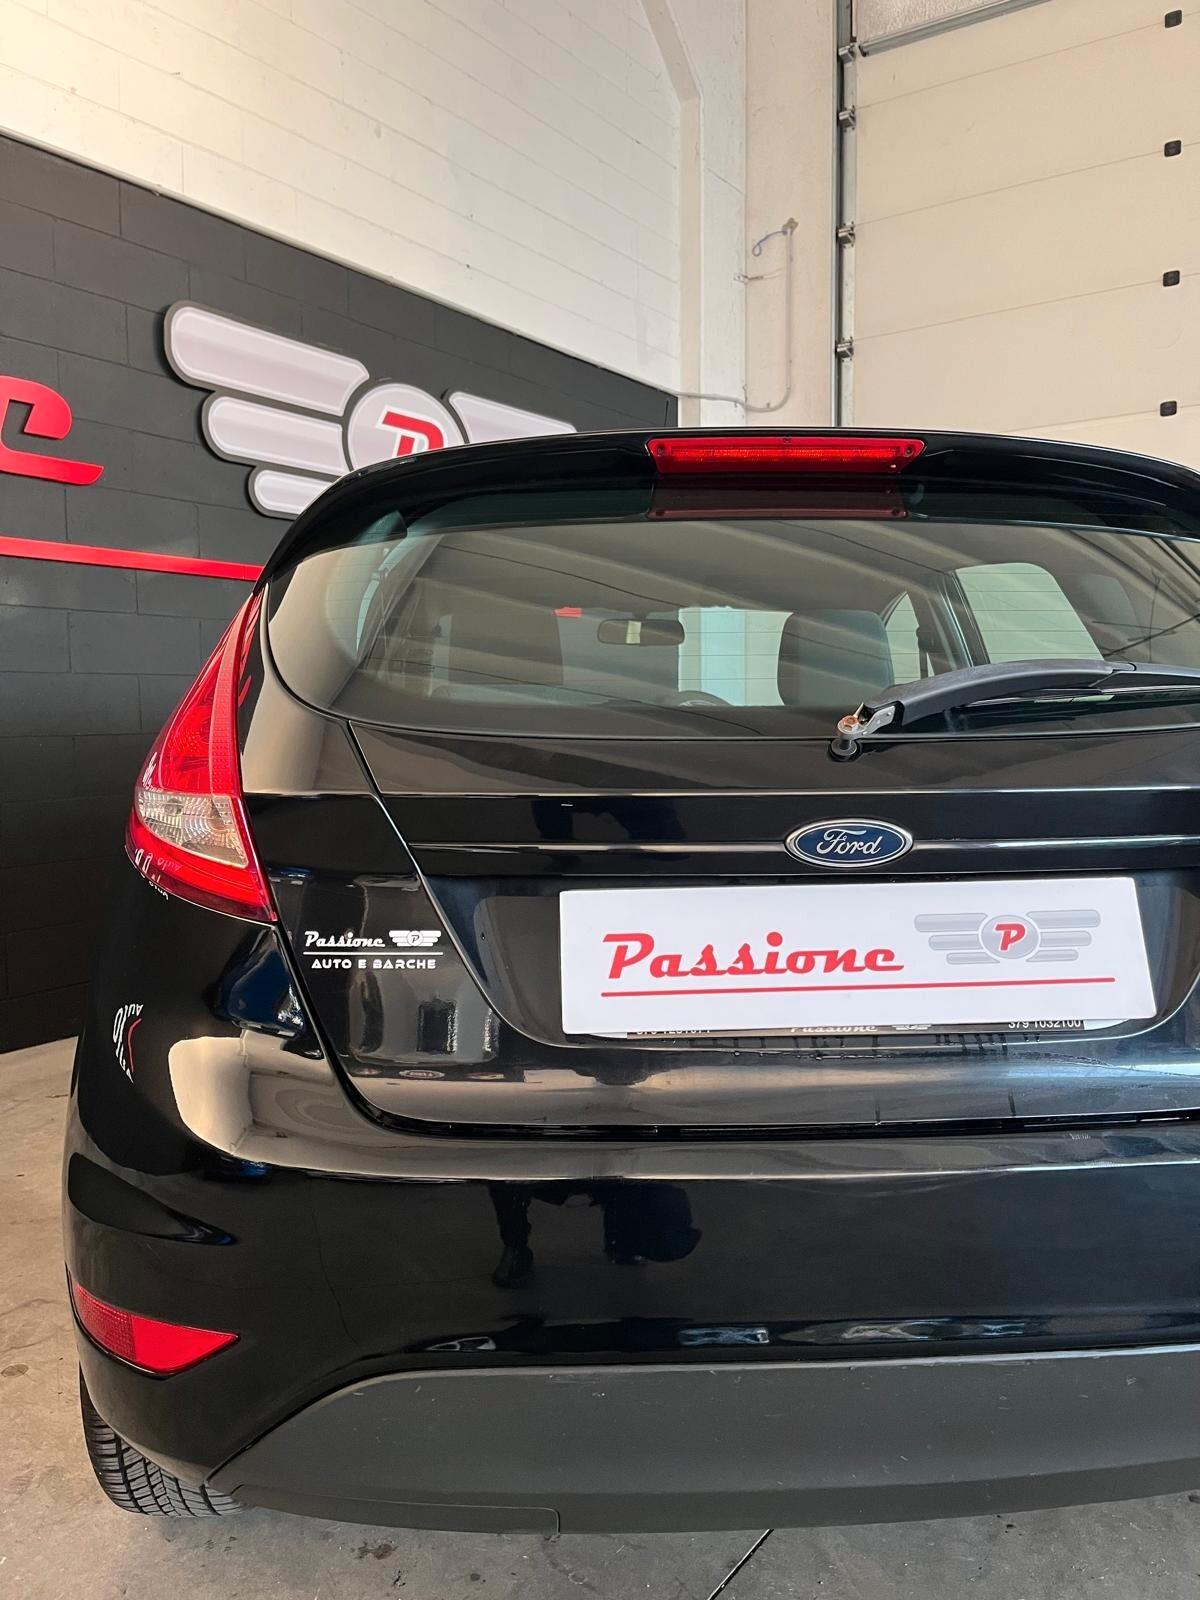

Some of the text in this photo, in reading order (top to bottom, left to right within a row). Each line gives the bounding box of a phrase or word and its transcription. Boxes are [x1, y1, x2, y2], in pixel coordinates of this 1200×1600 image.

[816, 828, 882, 854] Ford
[304, 930, 386, 947] Passione
[602, 923, 1026, 980] Passione P
[311, 958, 437, 969] AUTO E BARCHE
